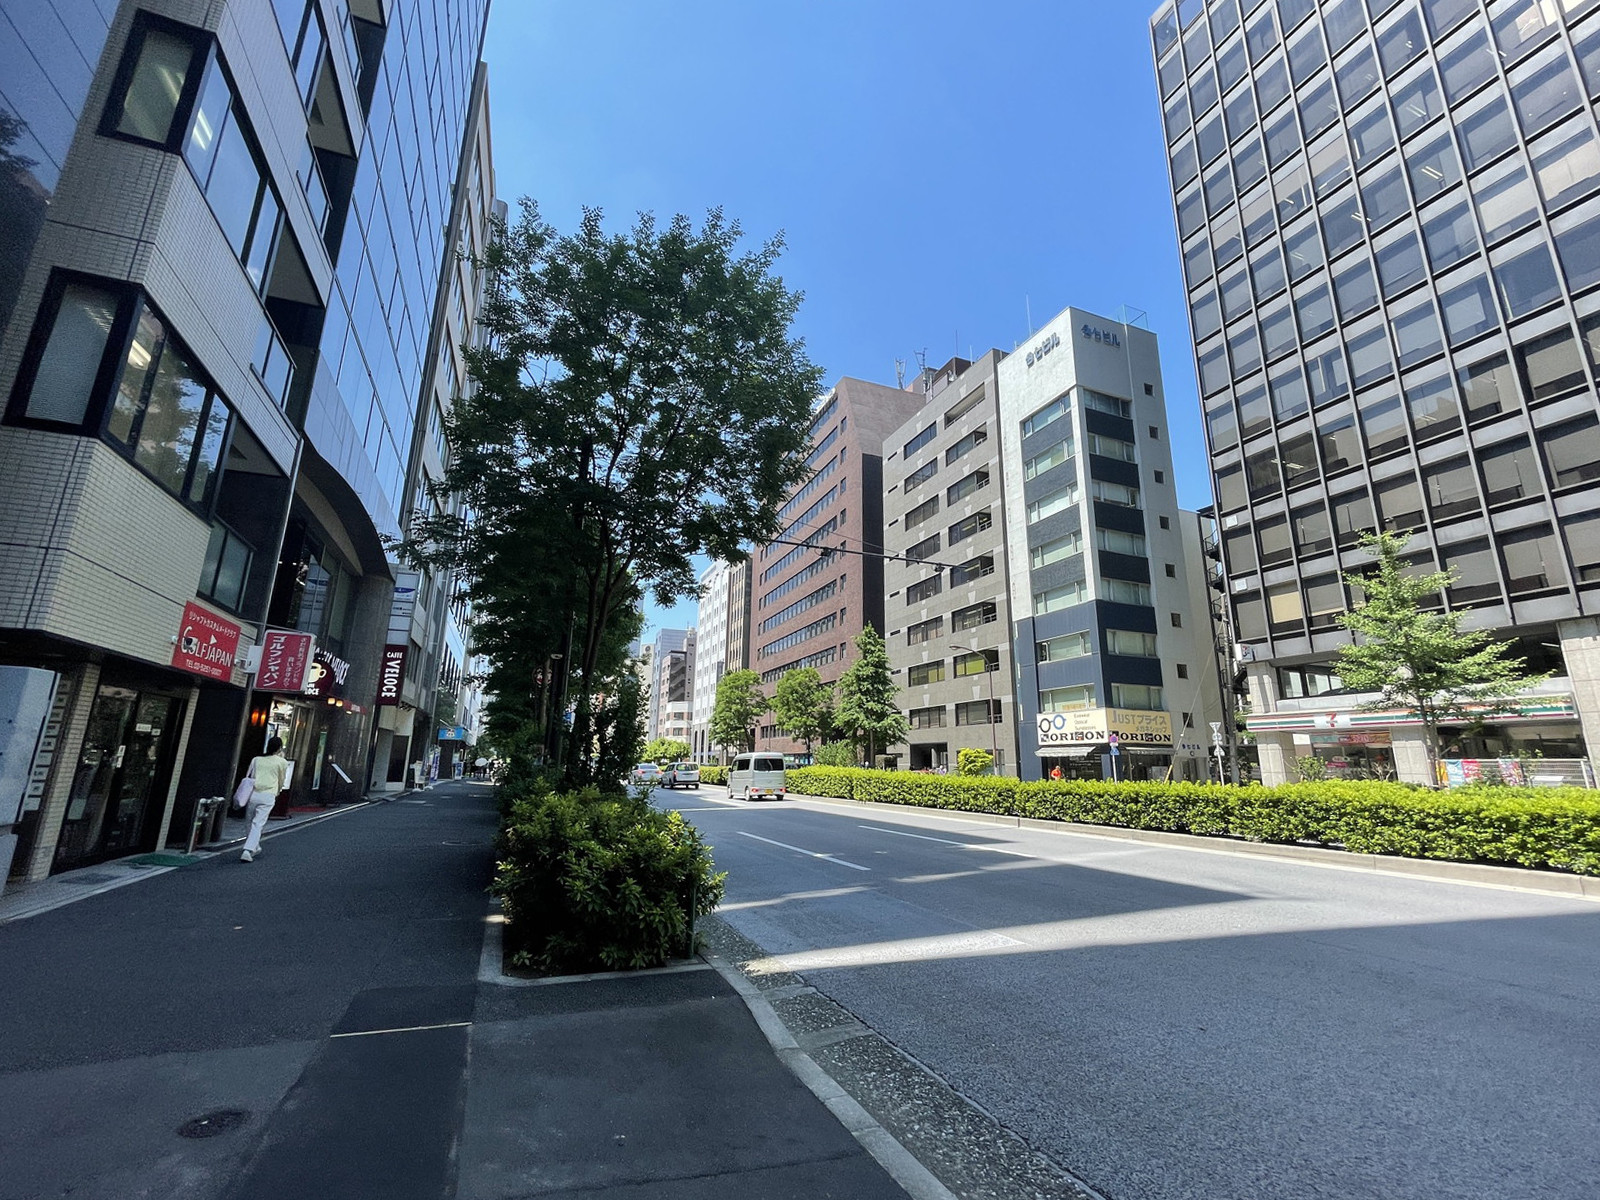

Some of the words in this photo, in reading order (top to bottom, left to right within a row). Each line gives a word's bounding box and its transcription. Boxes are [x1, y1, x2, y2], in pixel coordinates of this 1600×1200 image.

[263, 635, 287, 687] ゴルフジャパン
[381, 659, 401, 698] VELOCE
